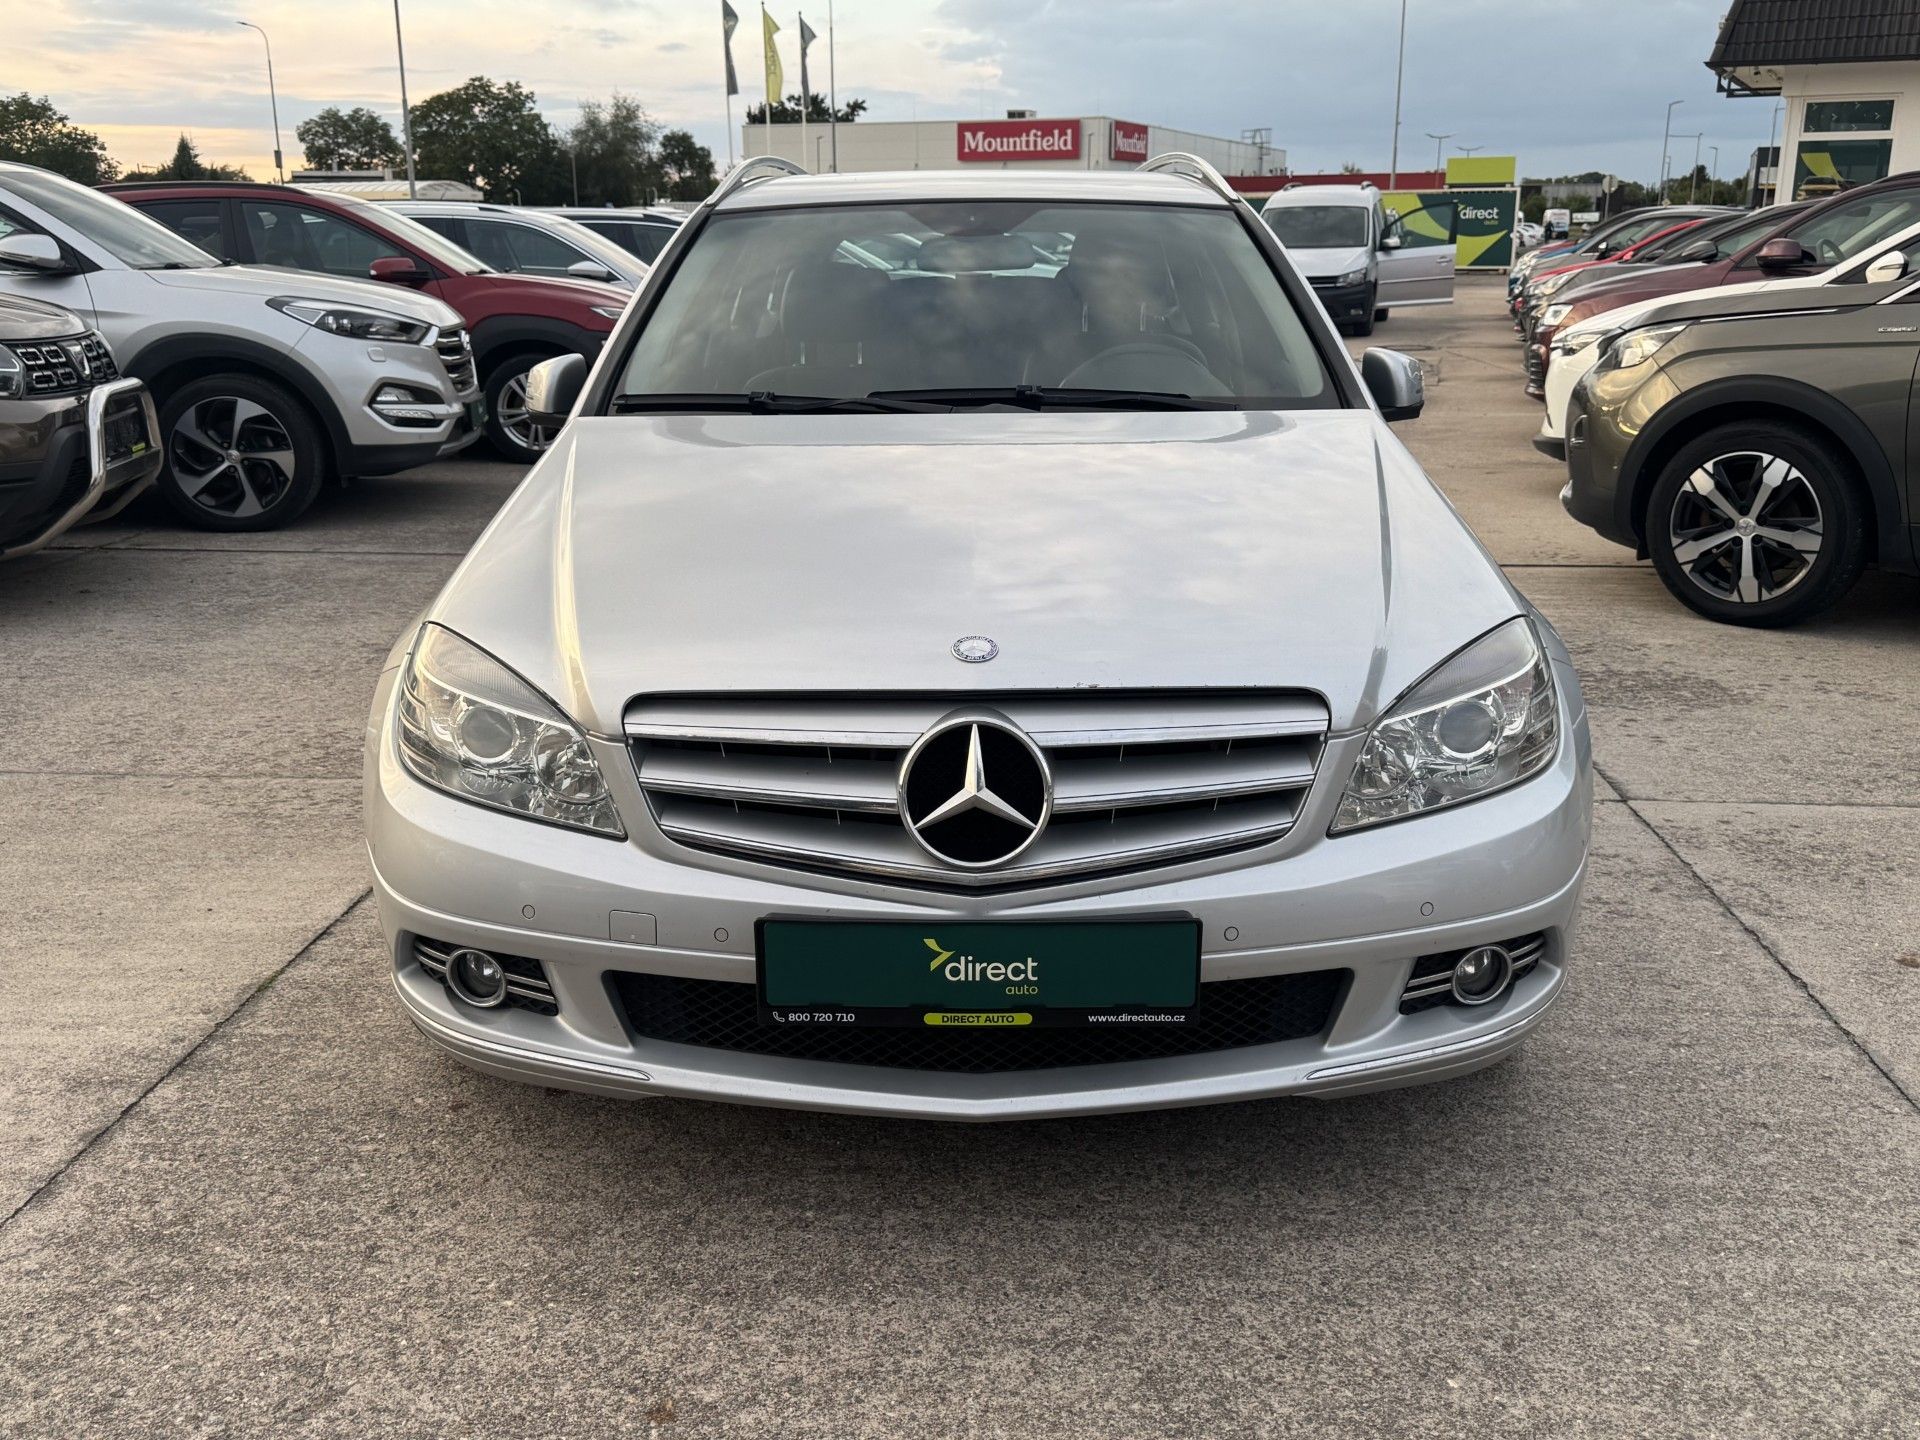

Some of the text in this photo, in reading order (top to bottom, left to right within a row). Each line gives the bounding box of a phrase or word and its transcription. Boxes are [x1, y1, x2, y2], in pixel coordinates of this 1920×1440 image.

[964, 128, 1073, 152] Mountfield
[1116, 130, 1146, 154] Mountfield
[1460, 206, 1499, 219] direct
[944, 955, 1039, 982] direct
[1005, 984, 1039, 995] auto
[788, 1012, 855, 1022] 800 720 710
[941, 1015, 1015, 1024] DIRECT AUTO
[1087, 1013, 1186, 1022] www.directauto.cz
